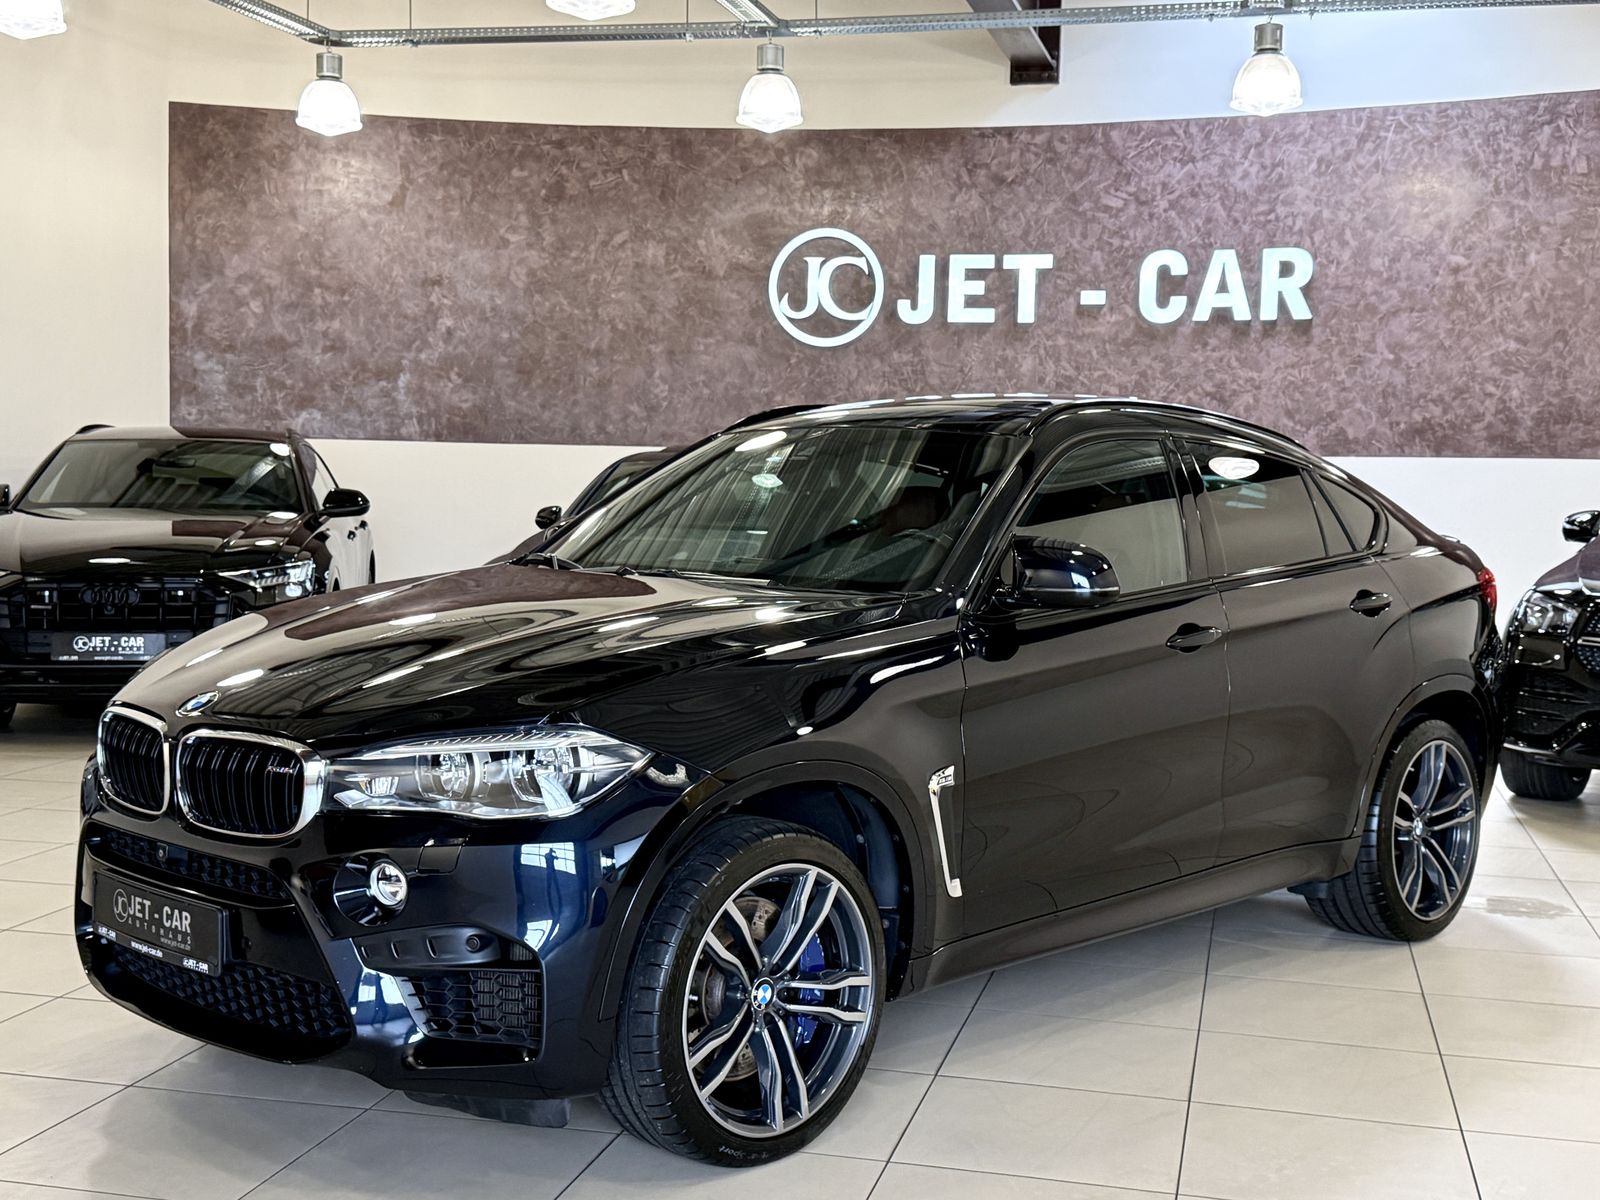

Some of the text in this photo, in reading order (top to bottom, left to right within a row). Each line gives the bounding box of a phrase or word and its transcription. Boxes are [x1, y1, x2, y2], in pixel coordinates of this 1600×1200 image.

[896, 254, 1054, 325] JET
[1138, 247, 1315, 325] CAR
[89, 636, 112, 647] JET
[120, 636, 145, 647] CAR
[128, 895, 151, 920] JET
[163, 906, 191, 933] CAR
